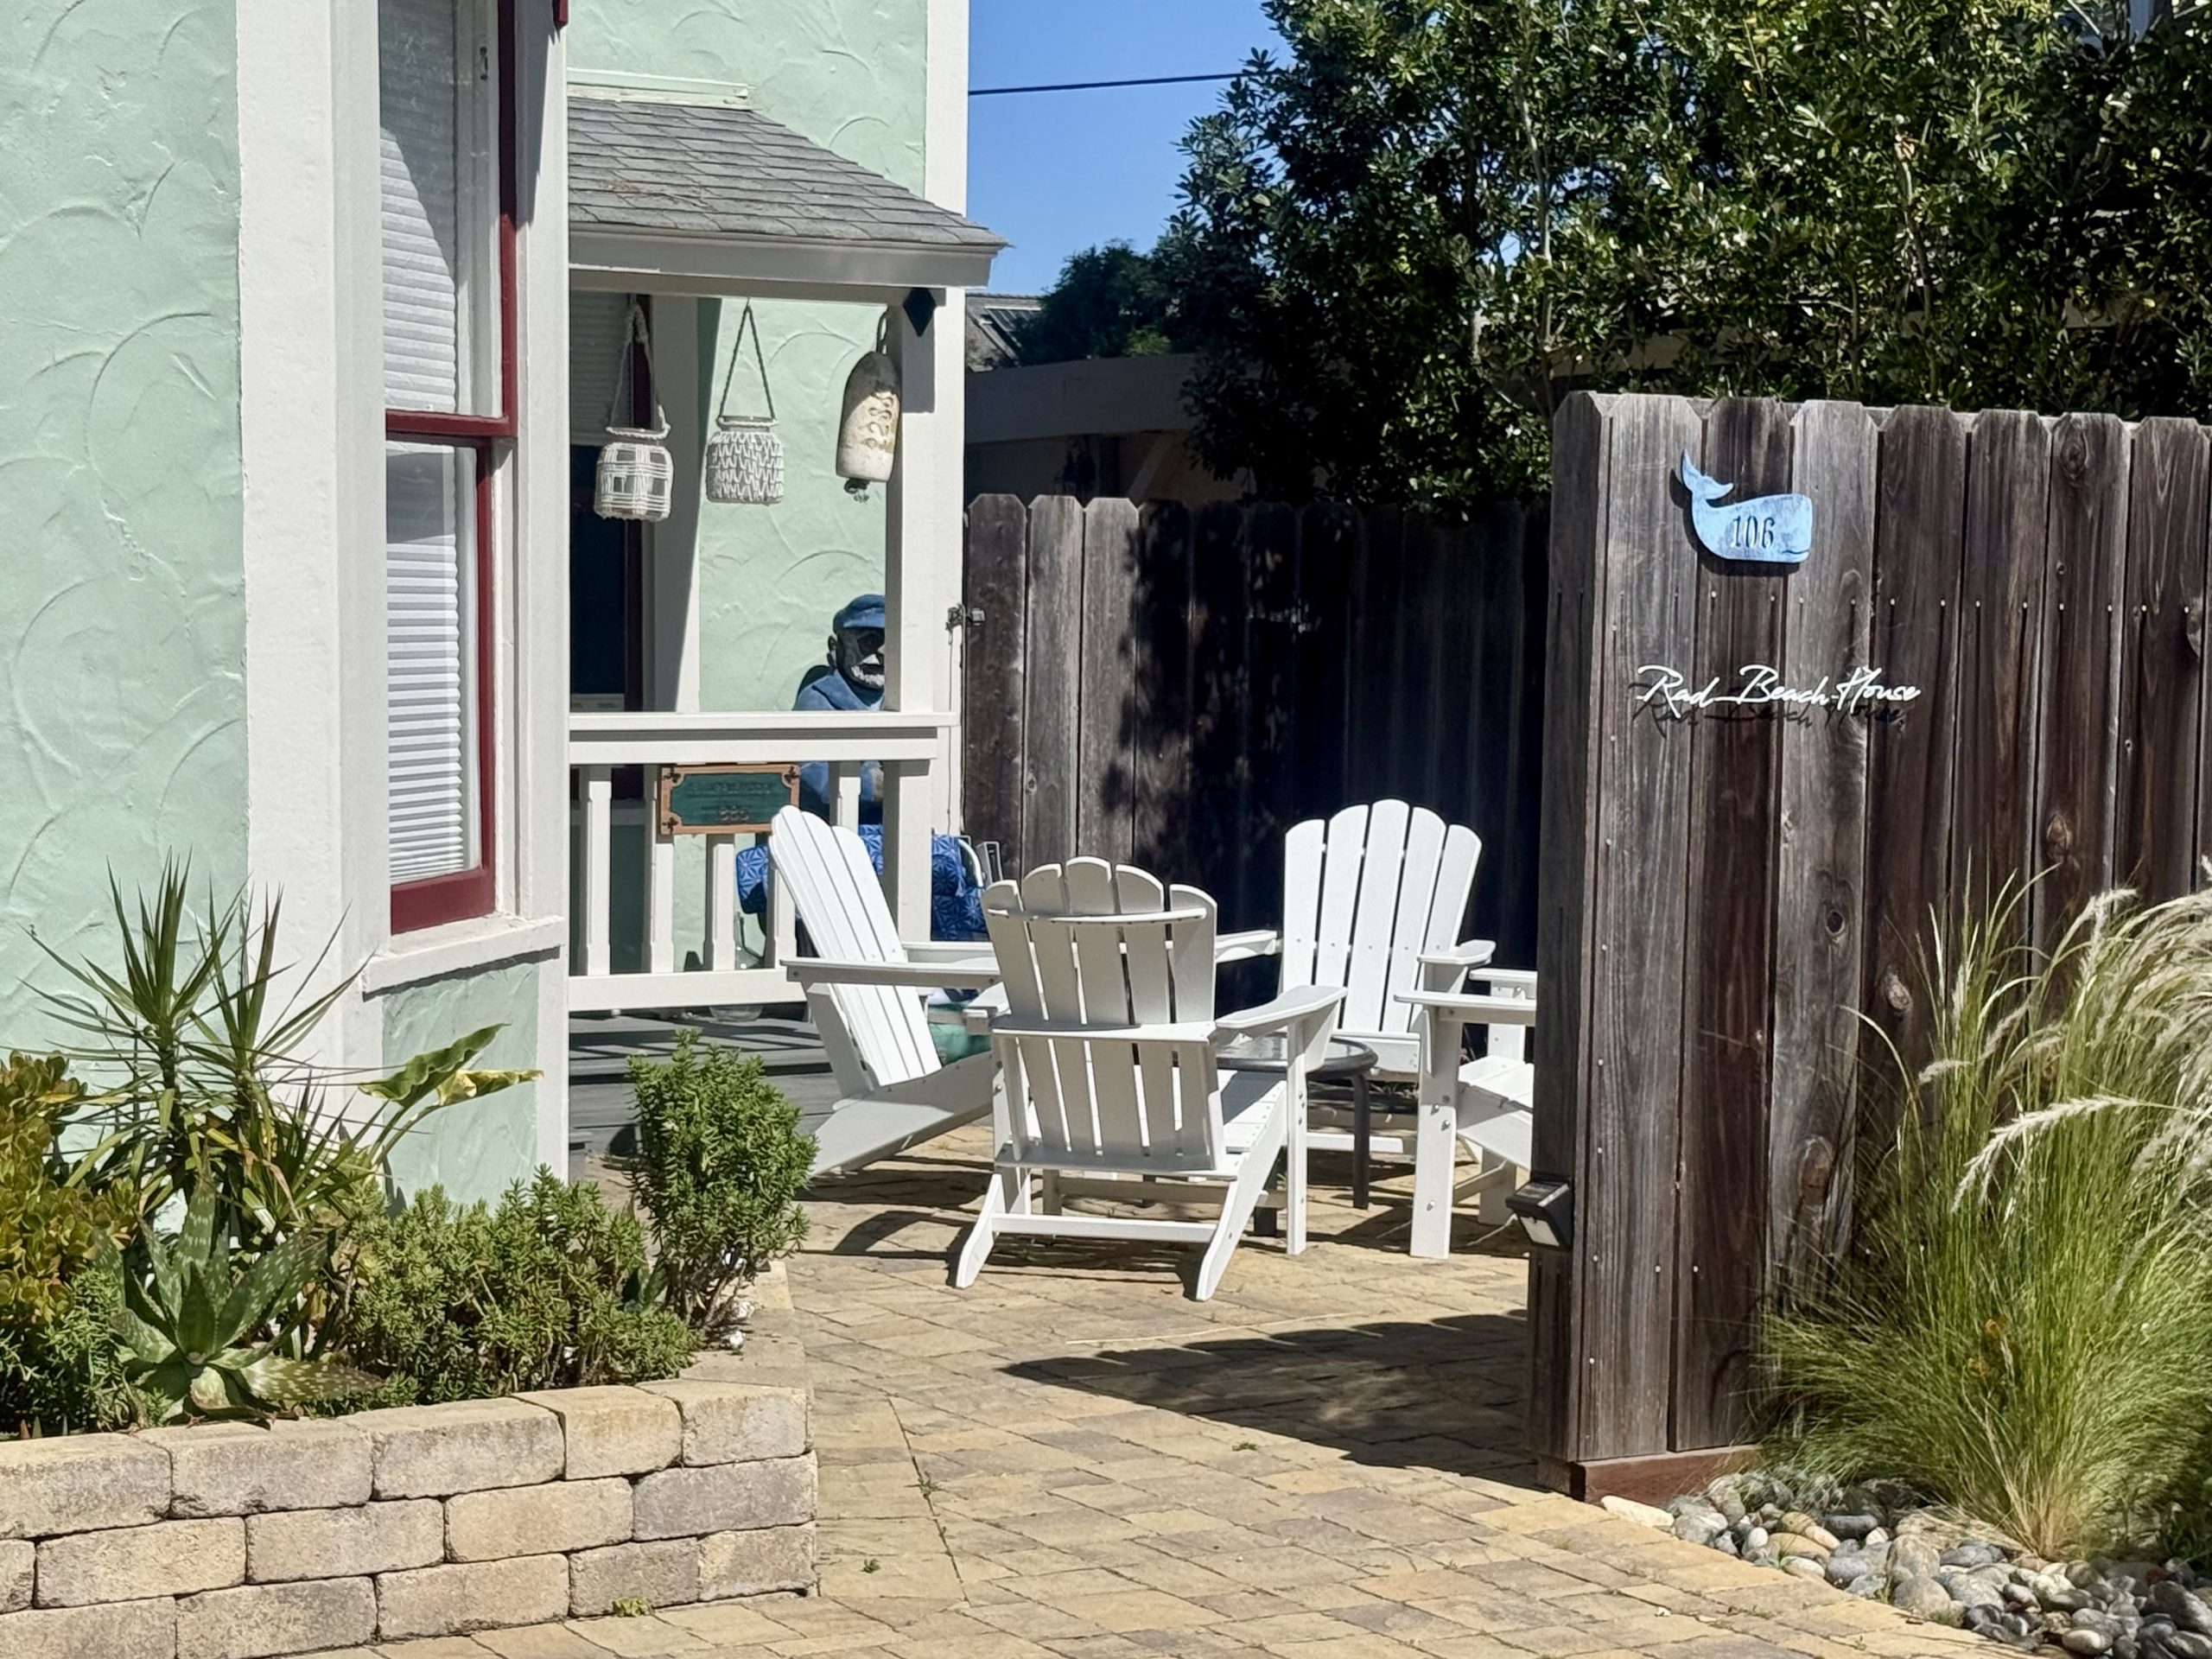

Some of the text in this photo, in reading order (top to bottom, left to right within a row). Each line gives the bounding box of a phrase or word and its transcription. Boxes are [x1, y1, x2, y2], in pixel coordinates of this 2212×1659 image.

[1731, 515, 1776, 549] 106
[1636, 664, 1922, 719] Rad Beach House
